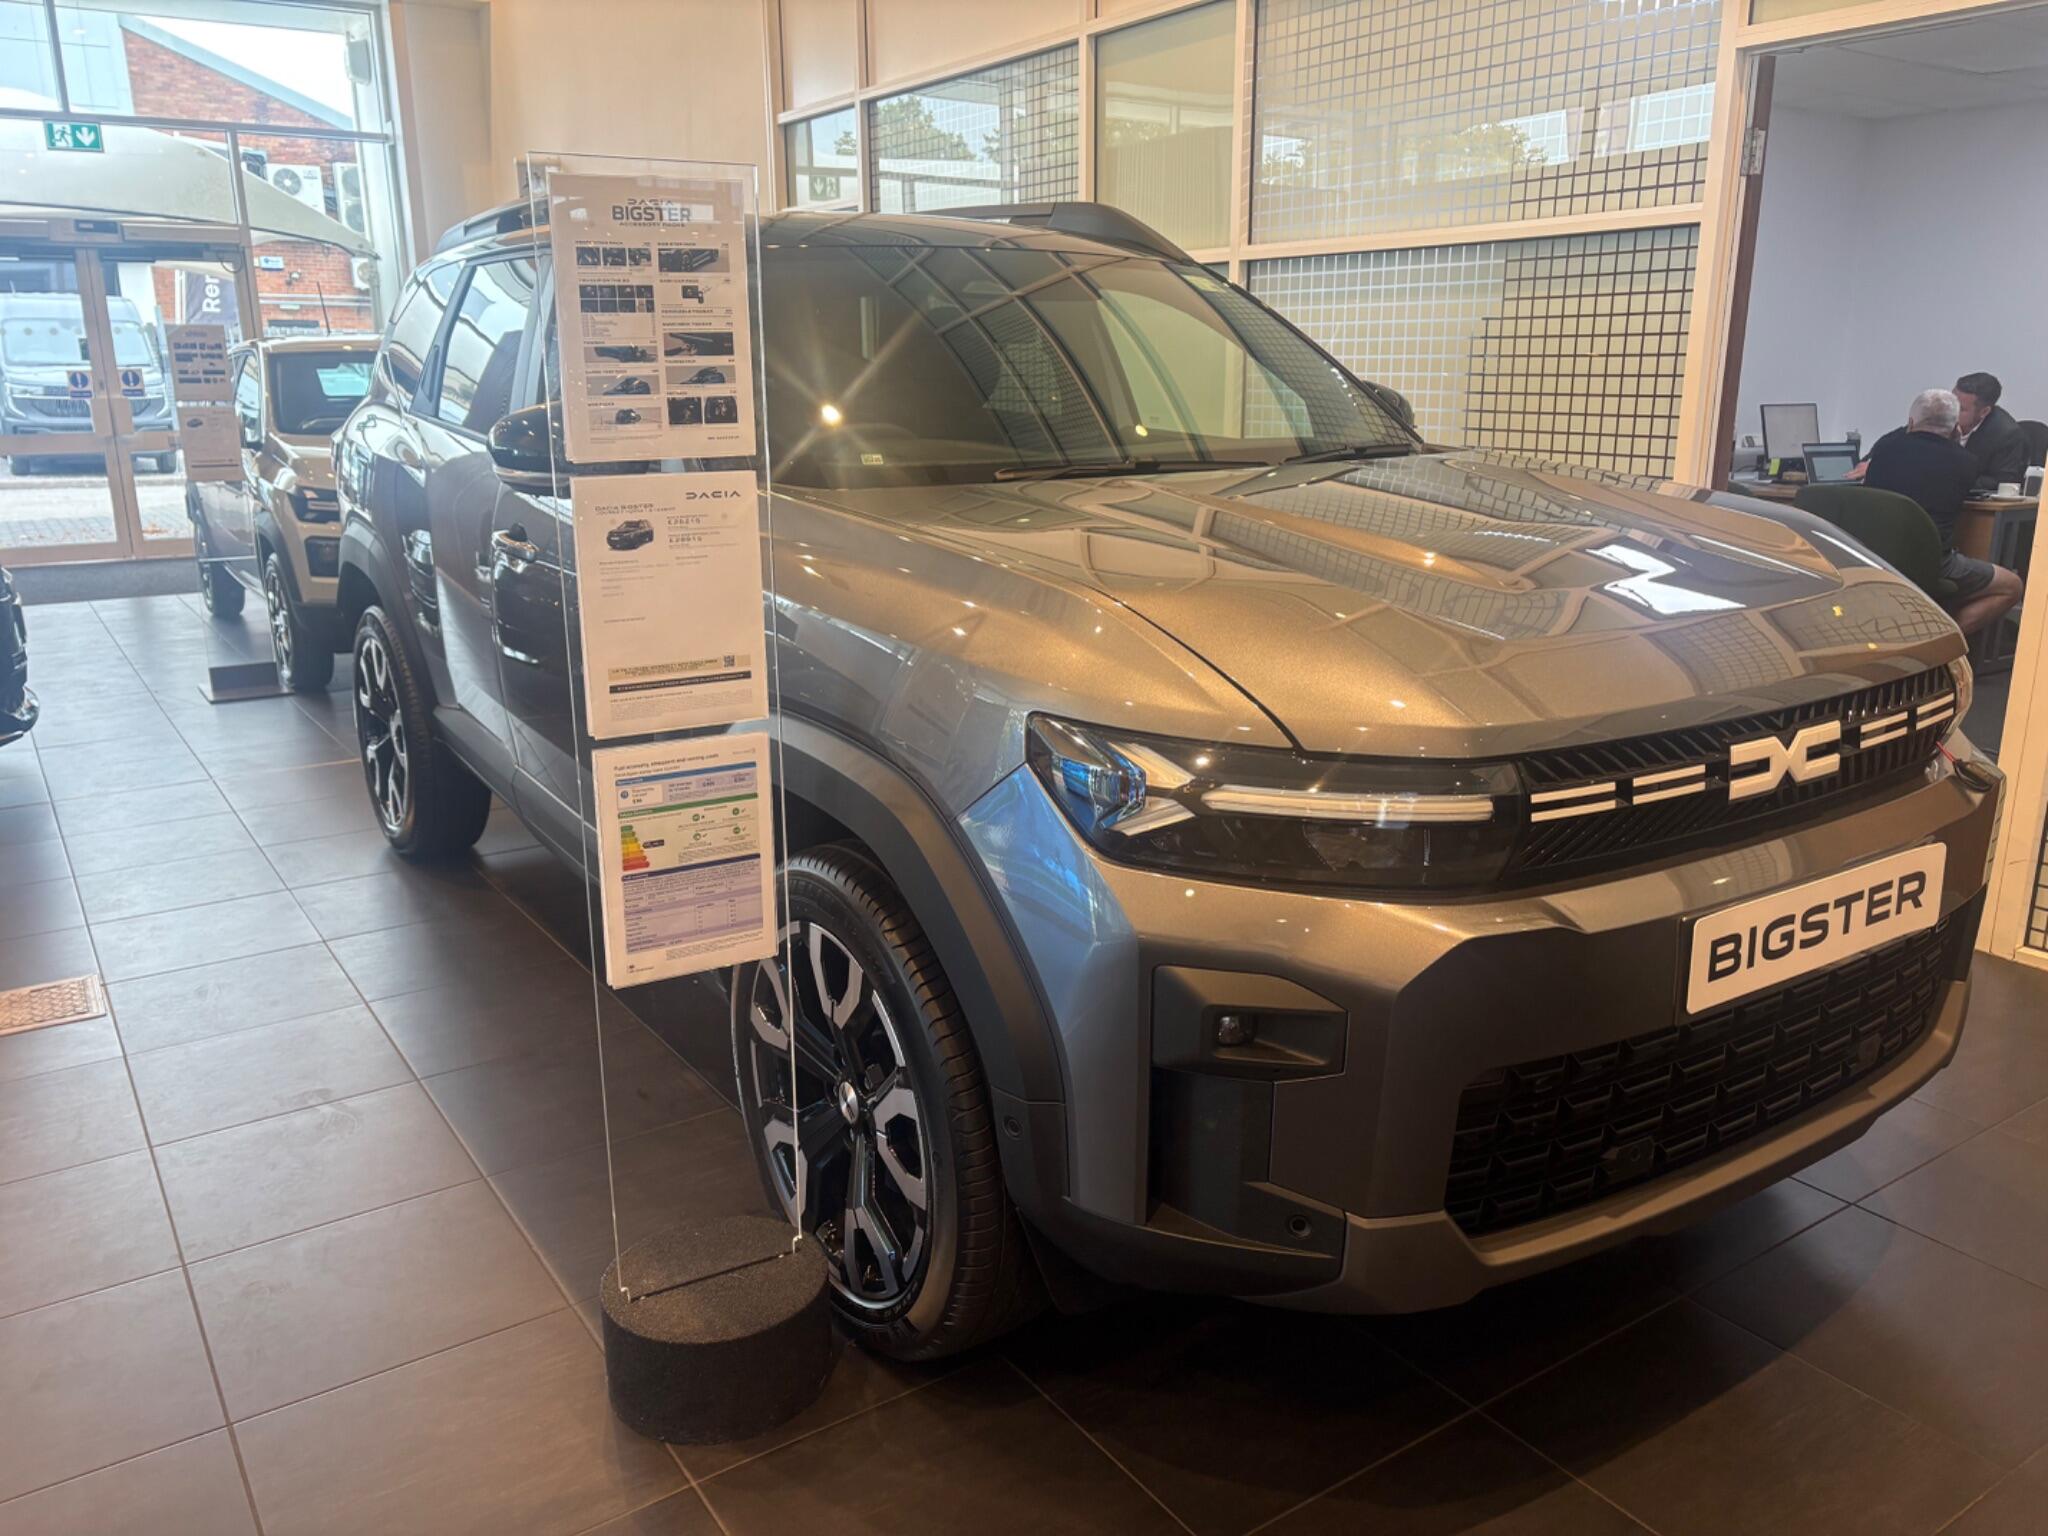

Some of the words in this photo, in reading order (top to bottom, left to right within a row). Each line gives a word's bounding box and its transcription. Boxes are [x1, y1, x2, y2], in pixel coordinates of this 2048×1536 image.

[612, 205, 691, 222] BIGSTER
[686, 490, 741, 500] DACIA
[1708, 871, 1926, 983] BIGSTER
